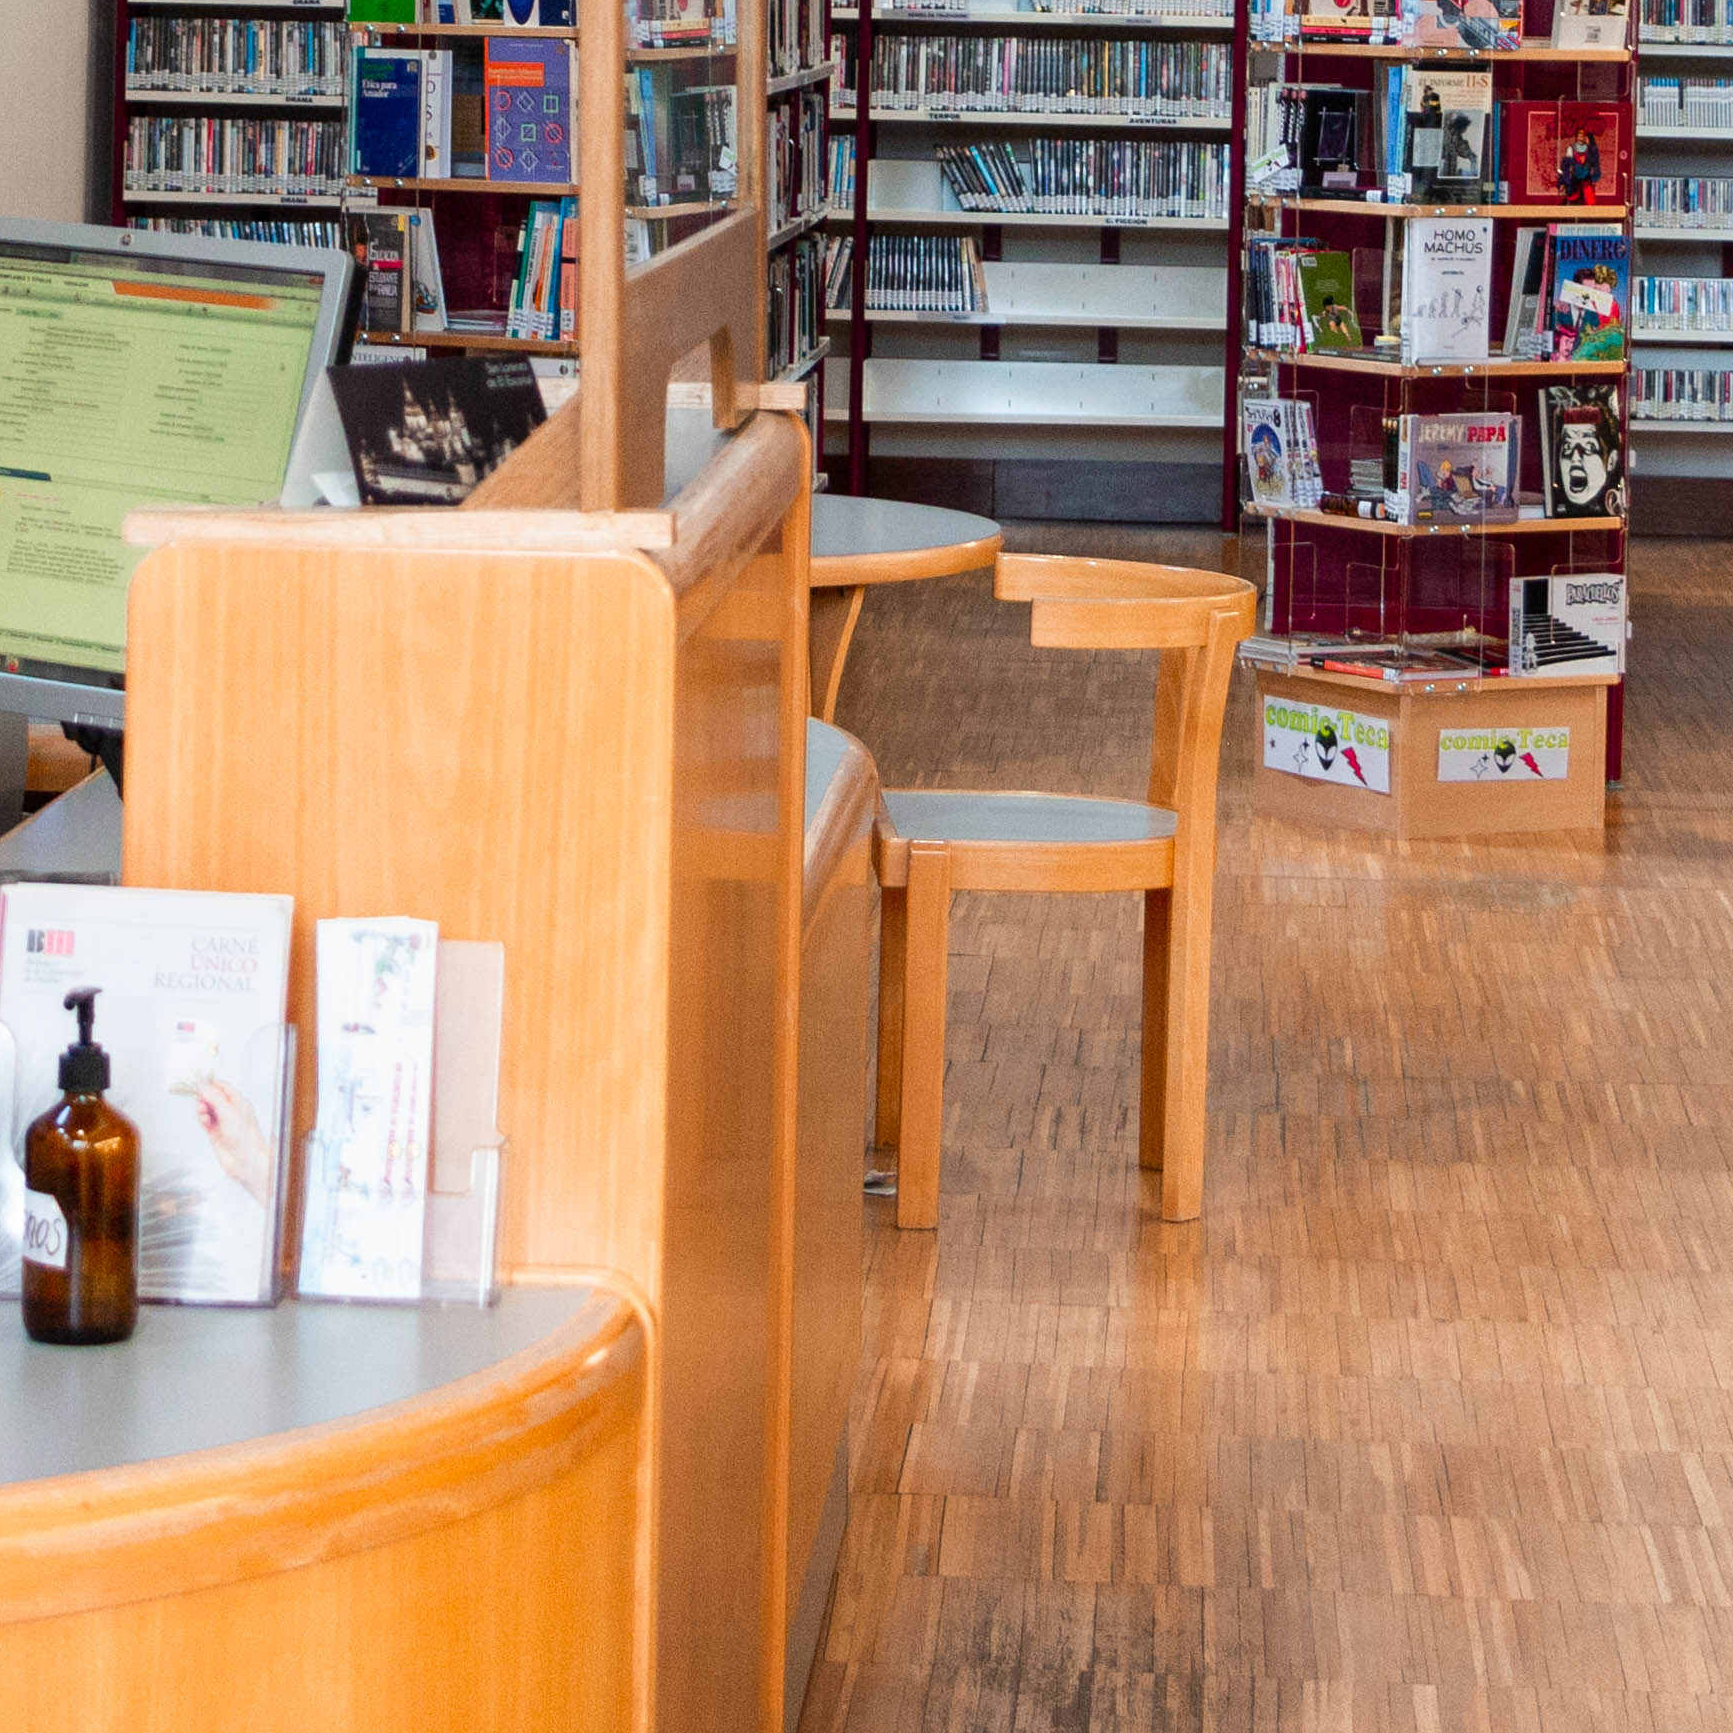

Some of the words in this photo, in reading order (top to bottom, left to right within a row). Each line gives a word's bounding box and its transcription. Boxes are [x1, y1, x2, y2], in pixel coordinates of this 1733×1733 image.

[1433, 229, 1476, 242] HOMO
[1424, 241, 1483, 255] MACHUS
[1560, 238, 1628, 260] DINERO
[1417, 423, 1465, 443] JEREMY
[1467, 420, 1508, 443] PAPÁ
[191, 935, 260, 955] CARNÉ
[153, 972, 255, 993] REGIONAL
